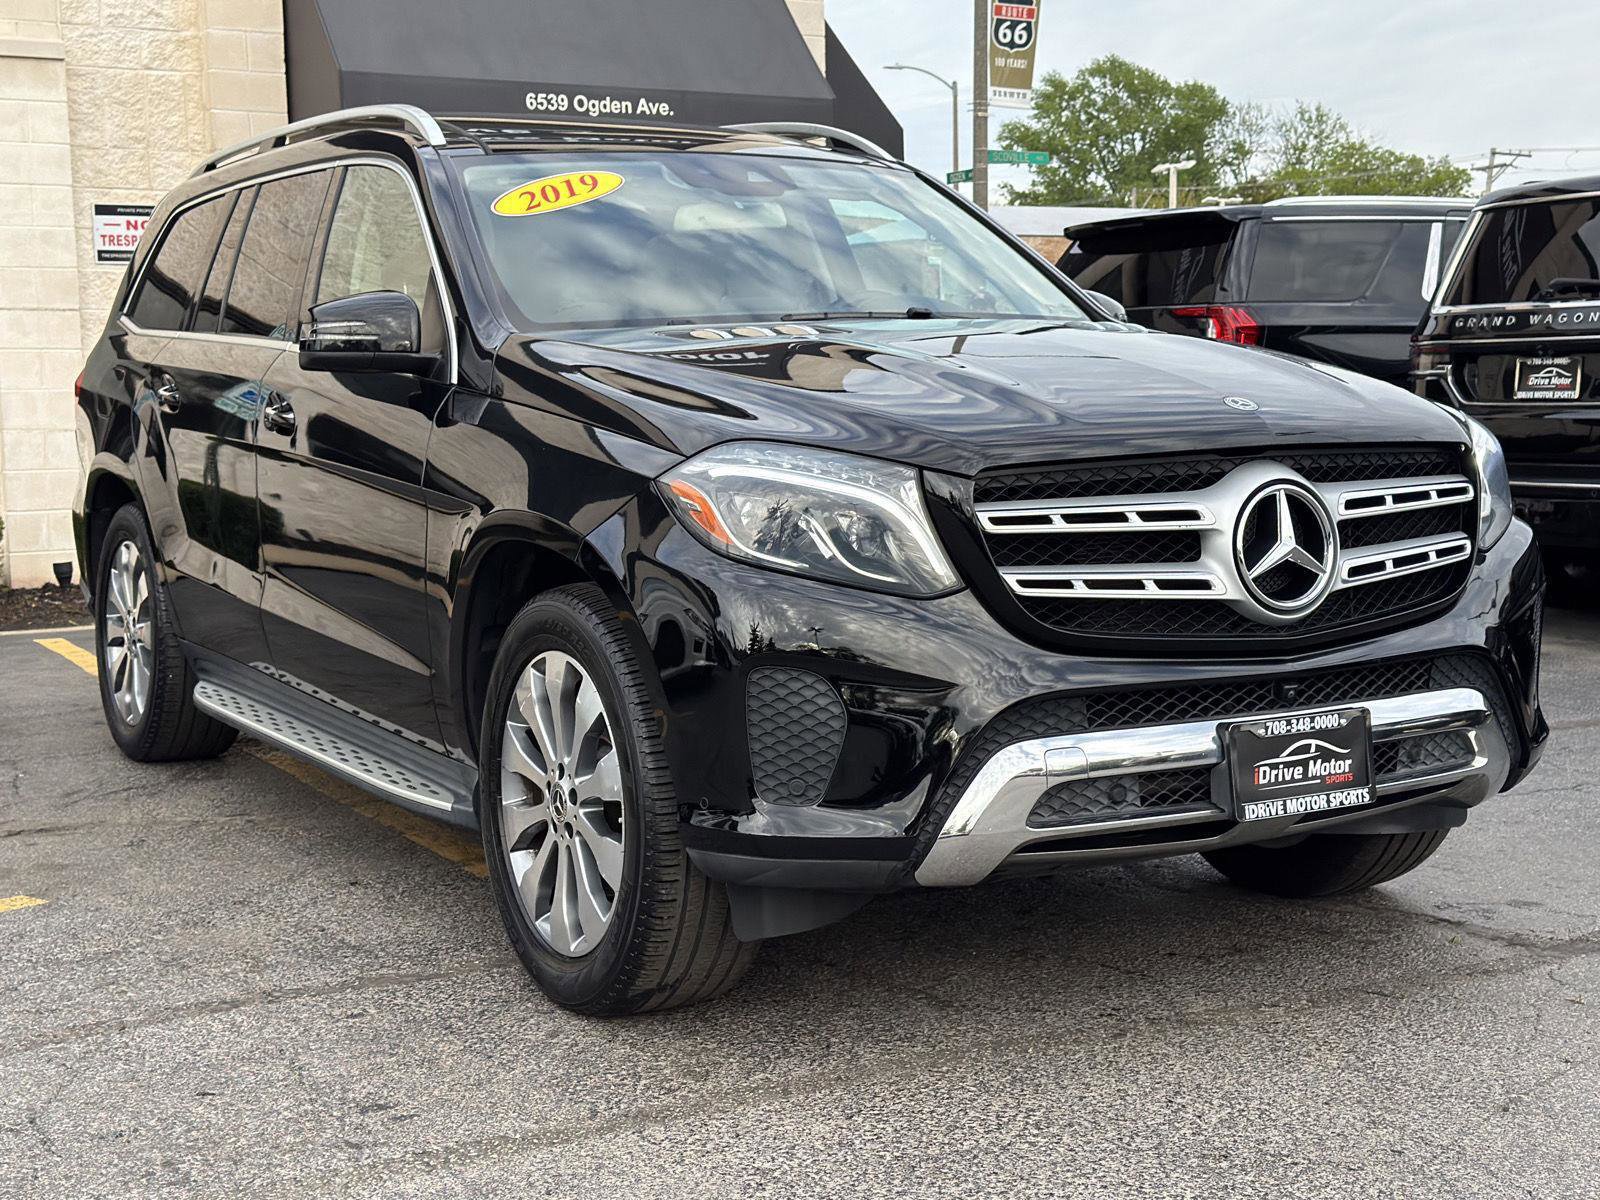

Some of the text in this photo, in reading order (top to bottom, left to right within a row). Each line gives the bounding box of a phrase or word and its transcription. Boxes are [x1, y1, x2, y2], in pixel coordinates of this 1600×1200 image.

[1002, 6, 1029, 18] ROUTE
[998, 21, 1028, 45] 66
[525, 92, 675, 117] 6539 Ogden Ave.
[518, 174, 599, 212] 2019
[1455, 311, 1600, 328] GRAND WAGON
[1550, 376, 1573, 386] Motor
[1265, 714, 1340, 736] 708-348-0000
[1254, 758, 1353, 785] iDrive Motor
[1325, 772, 1354, 784] SPORTS
[1286, 794, 1328, 813] MOTOR
[1329, 787, 1371, 808] SPORTS
